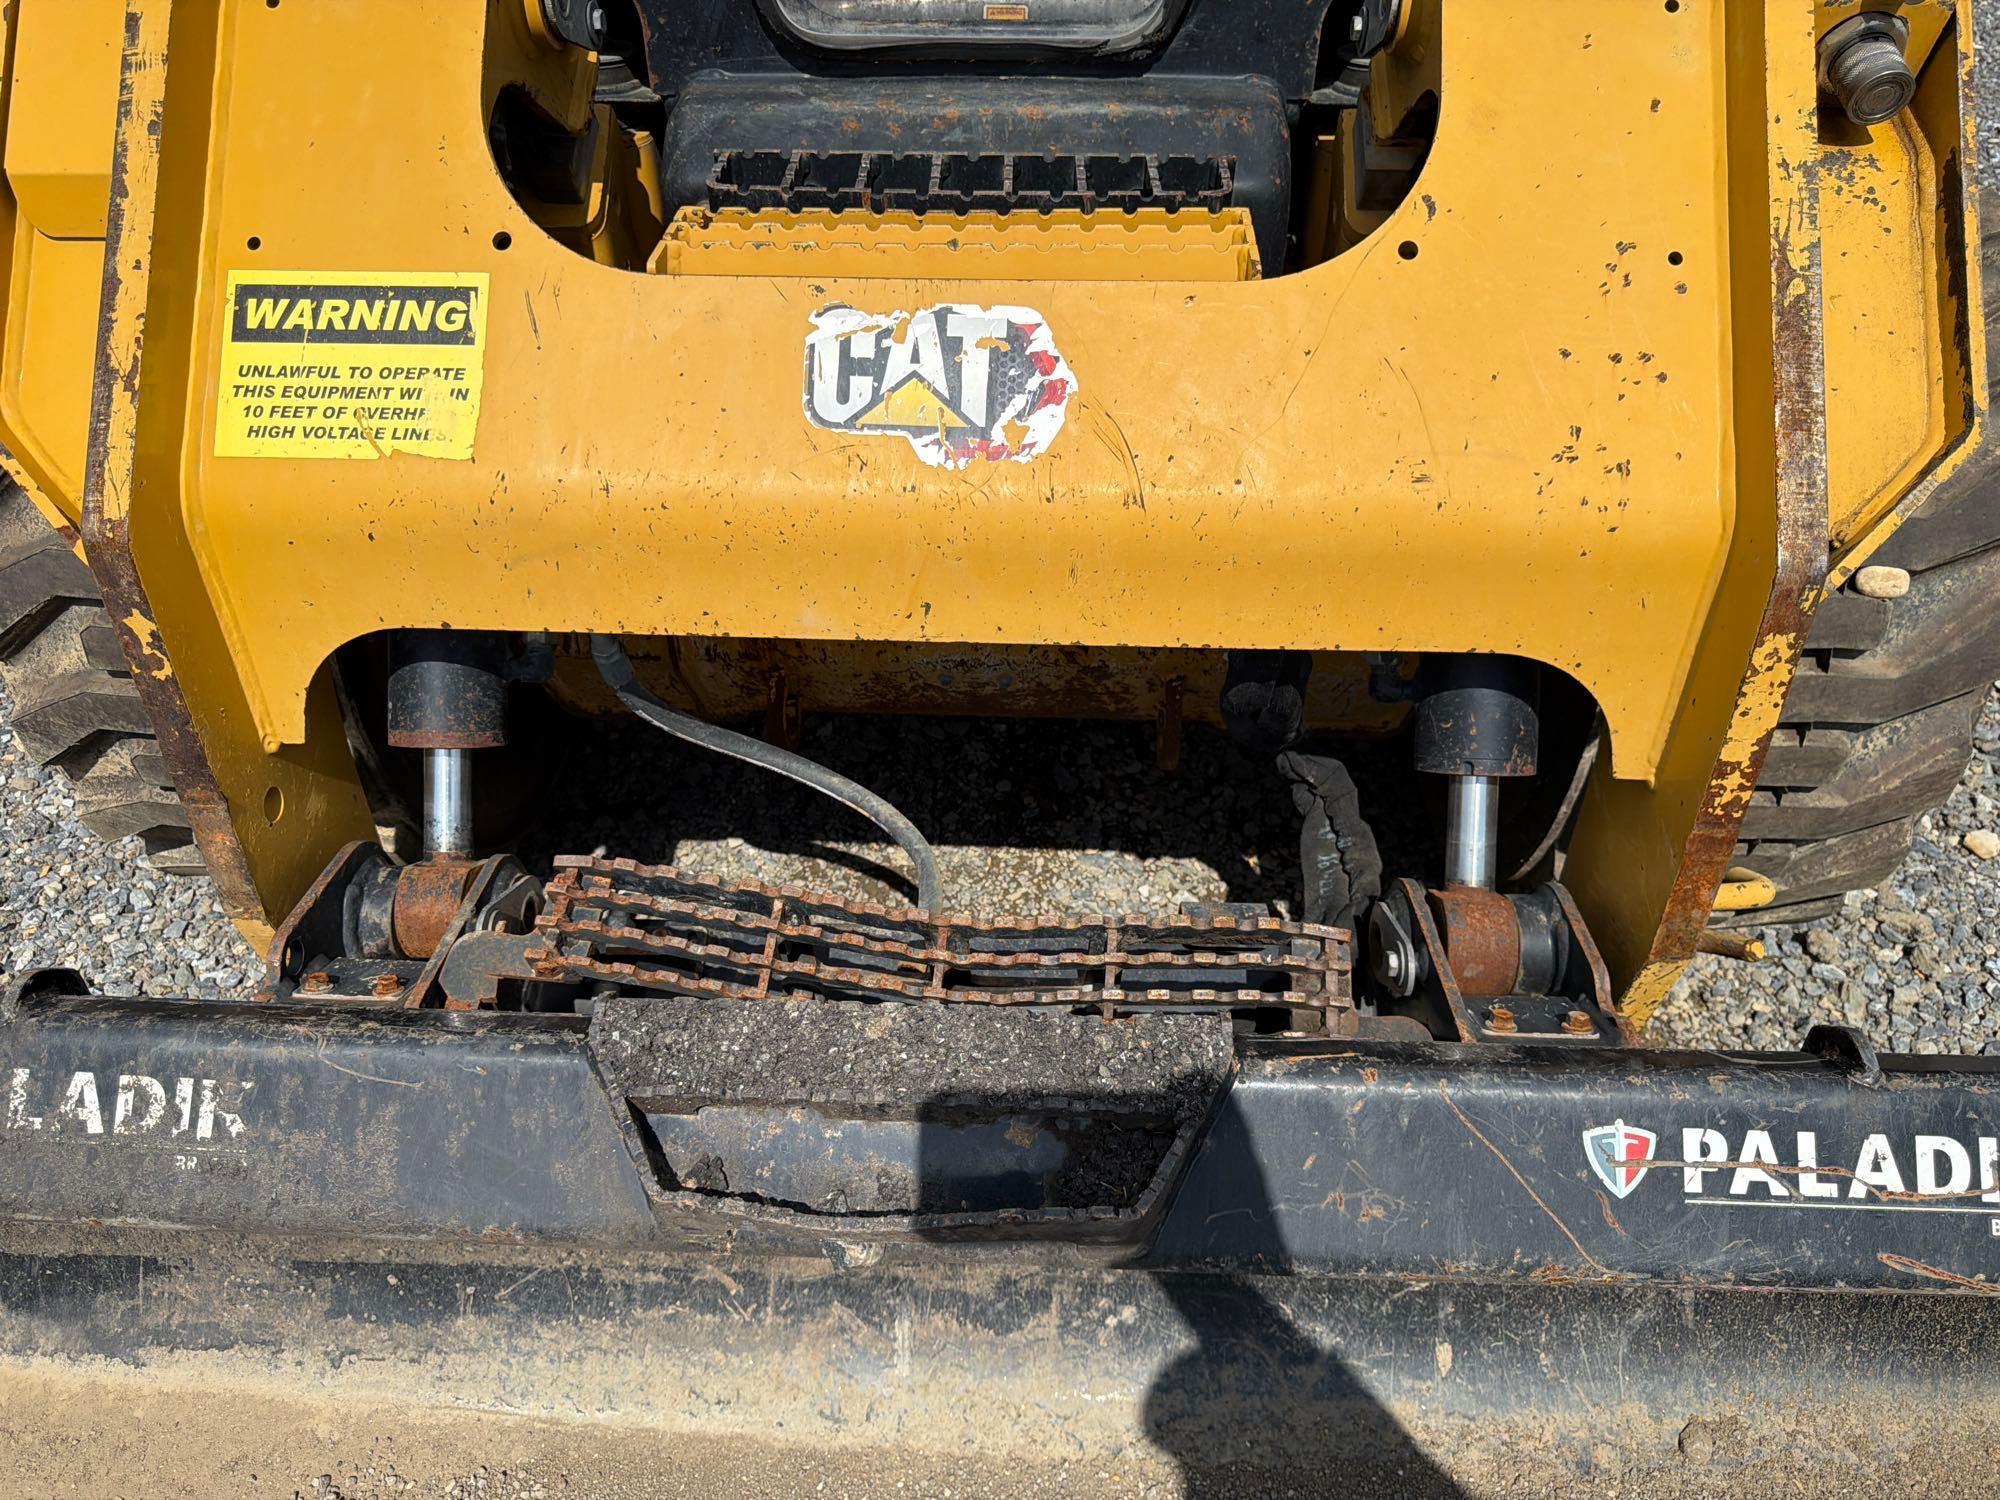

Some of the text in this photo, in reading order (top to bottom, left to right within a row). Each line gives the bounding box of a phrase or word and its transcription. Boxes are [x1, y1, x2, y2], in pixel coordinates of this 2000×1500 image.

[245, 298, 469, 331] WARNING
[238, 365, 466, 381] UNLAWFUL TO OPERATE
[812, 306, 1008, 428] CAT
[232, 385, 470, 401] THIS EQUIPMENT WIIN
[243, 405, 264, 418] 10
[269, 405, 318, 419] FEET
[323, 406, 348, 419] OF
[247, 426, 295, 439] HIGH
[303, 427, 386, 440] VOLTAGE
